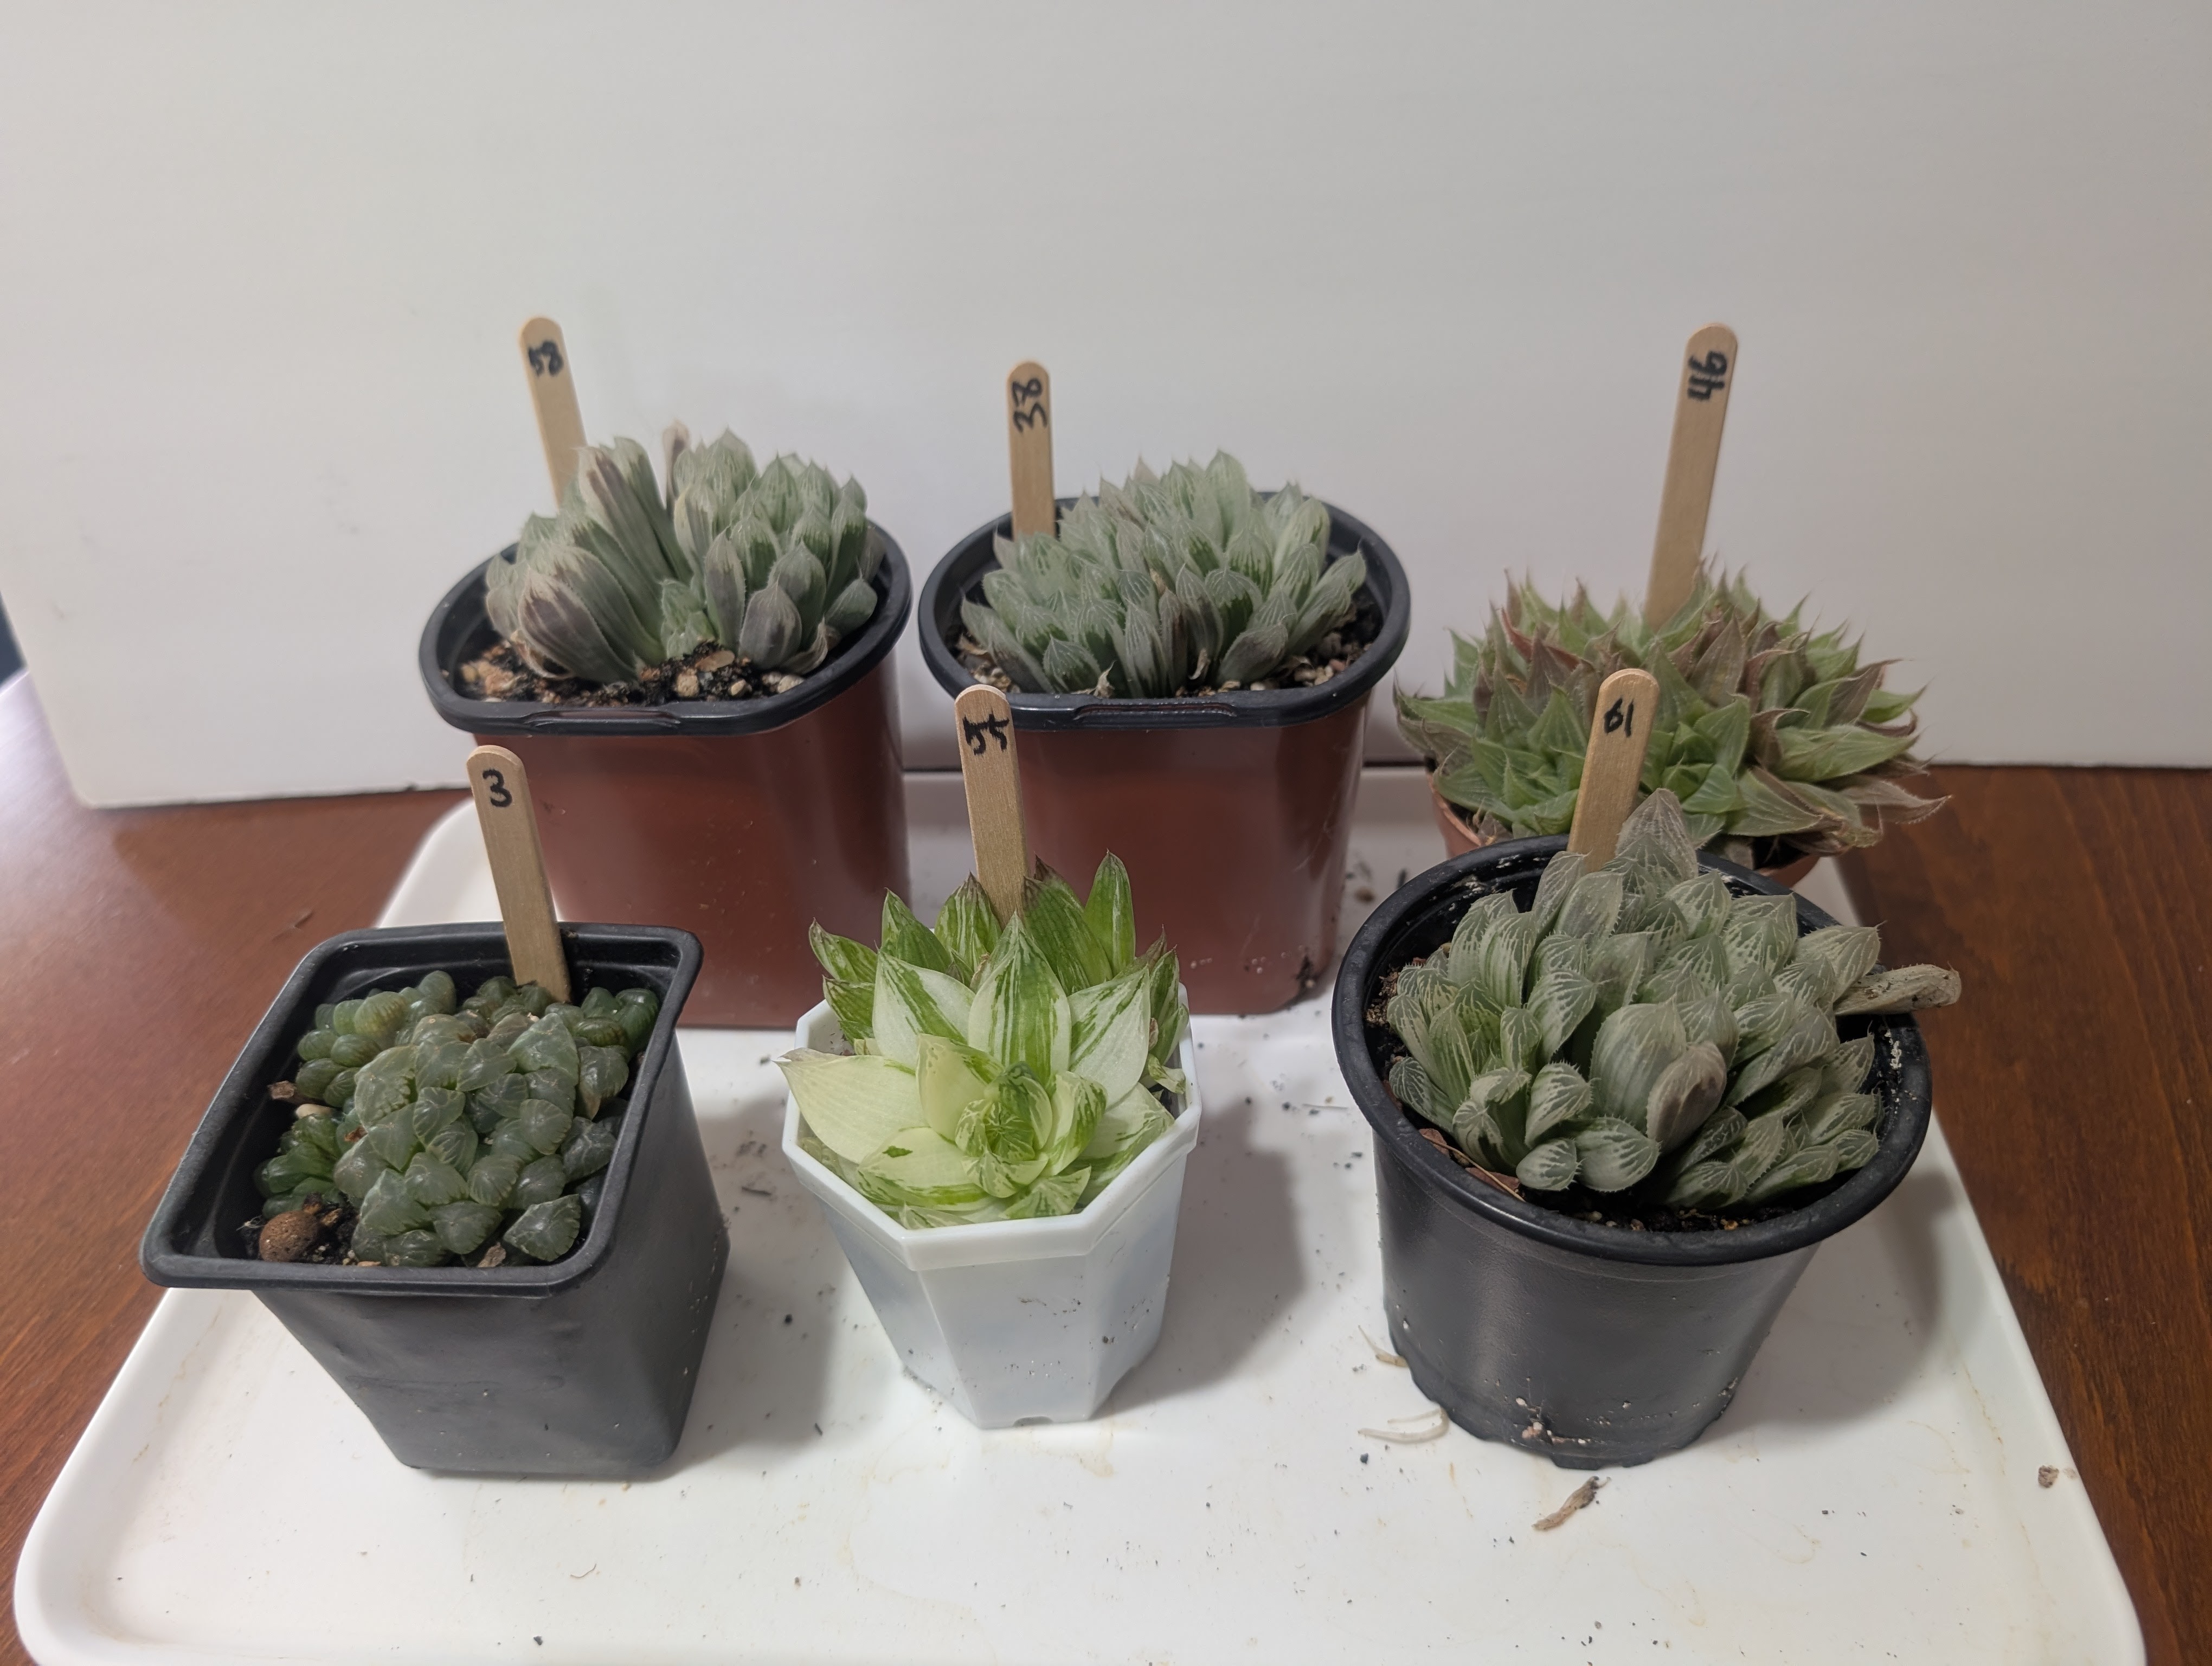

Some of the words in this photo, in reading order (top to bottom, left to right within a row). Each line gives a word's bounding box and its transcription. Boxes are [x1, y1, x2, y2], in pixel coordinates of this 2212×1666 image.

[1687, 351, 1728, 402] 46
[1012, 377, 1048, 433] 38
[962, 710, 1010, 755] 55
[1603, 696, 1634, 738] 61
[482, 768, 513, 808] 3
